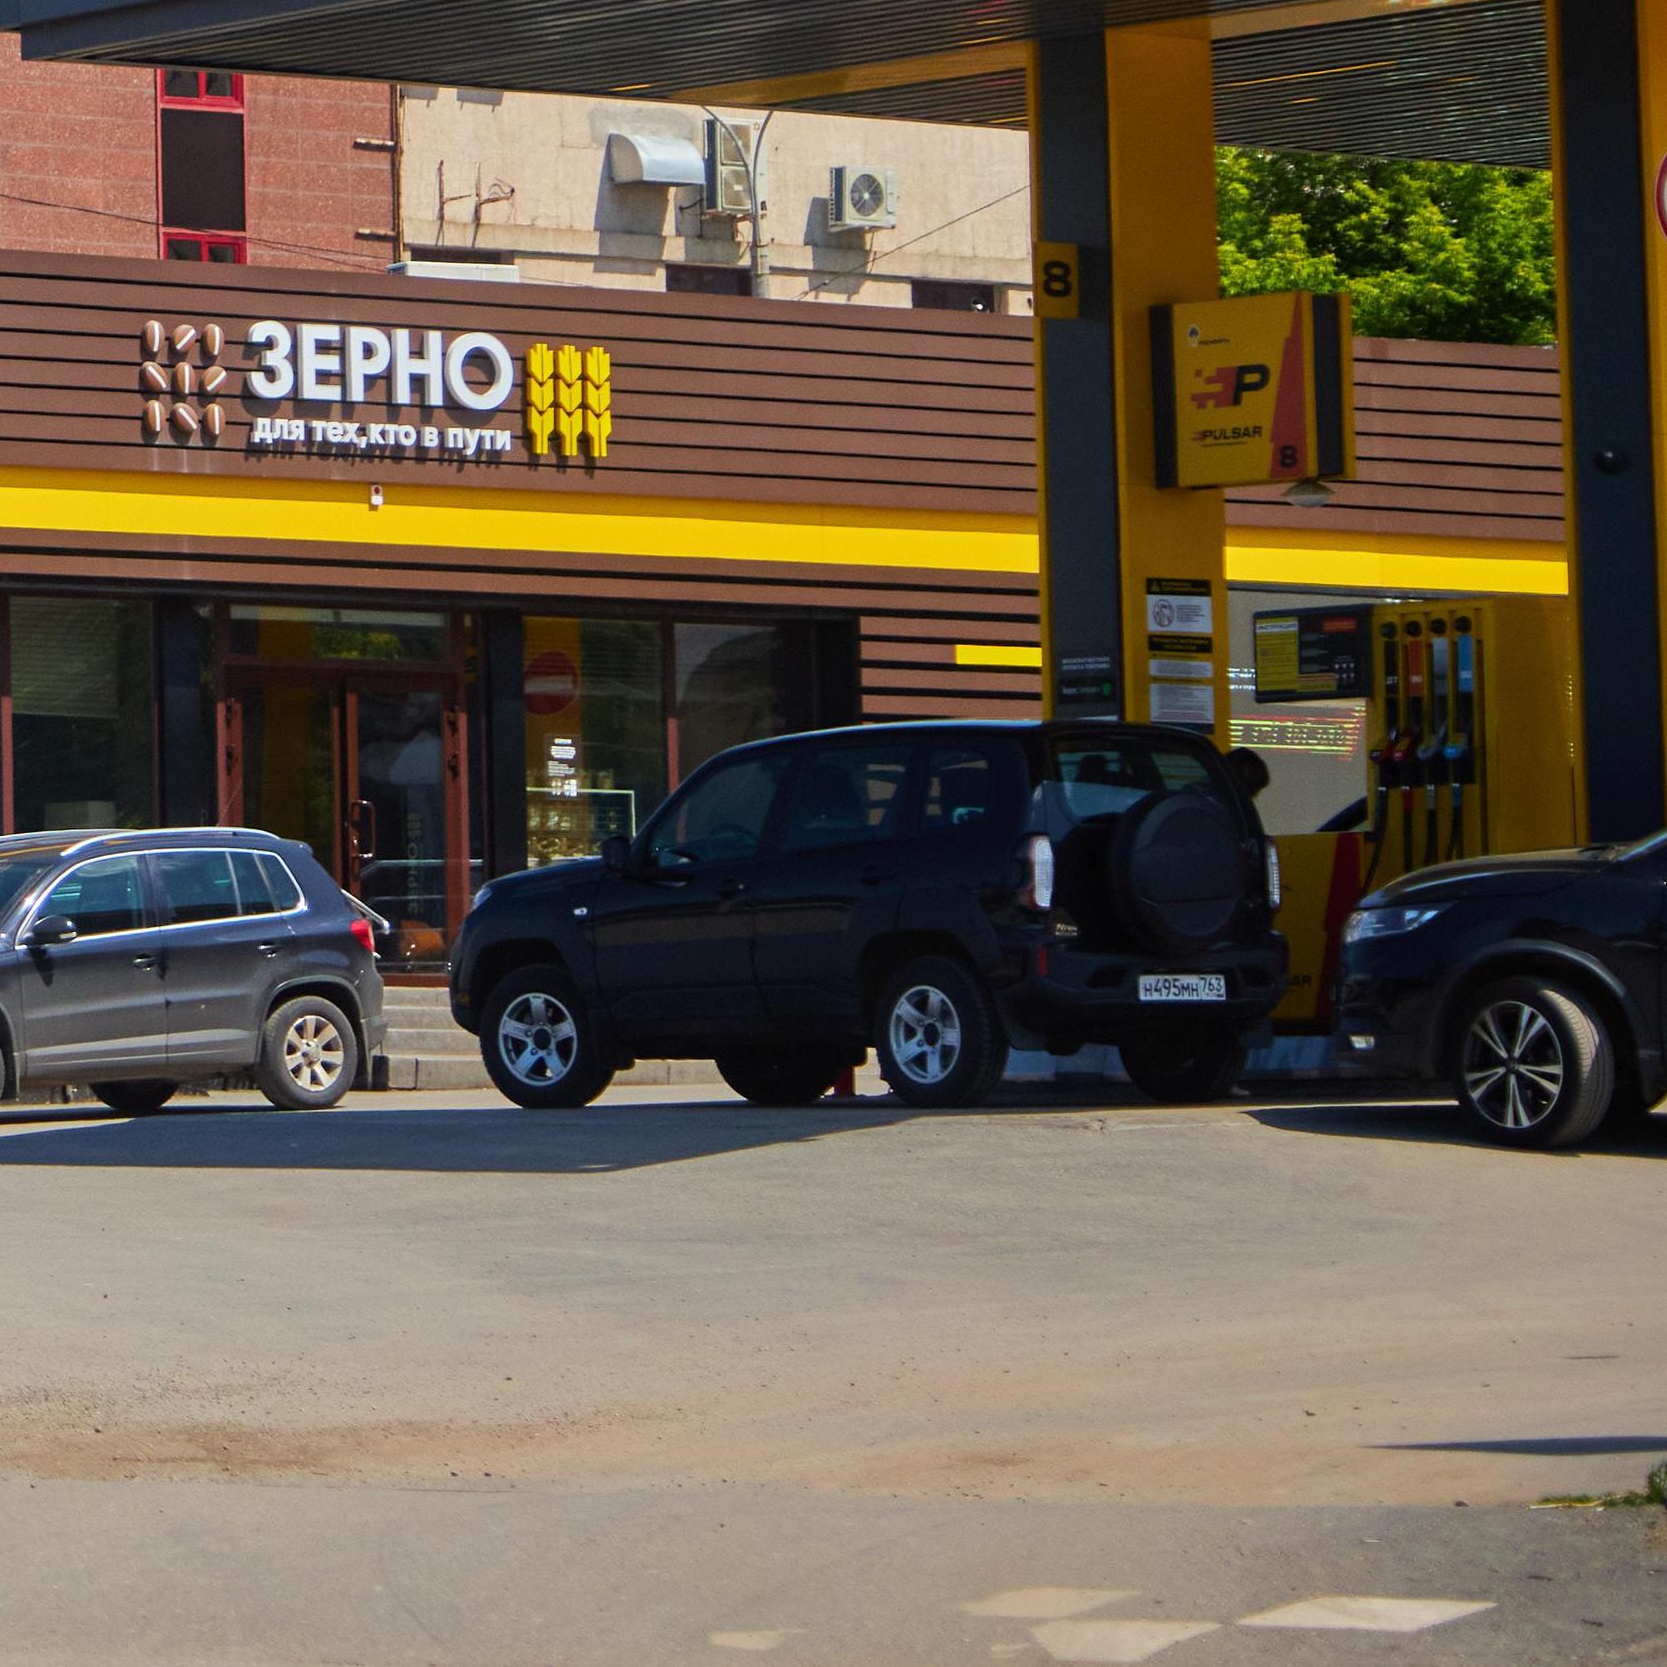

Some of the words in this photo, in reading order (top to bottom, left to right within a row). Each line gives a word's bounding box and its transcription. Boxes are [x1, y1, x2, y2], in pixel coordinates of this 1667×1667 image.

[1043, 261, 1071, 298] 8
[246, 320, 514, 411] ЗЕРНО
[1202, 426, 1263, 441] PULSAR
[1279, 445, 1298, 468] 8
